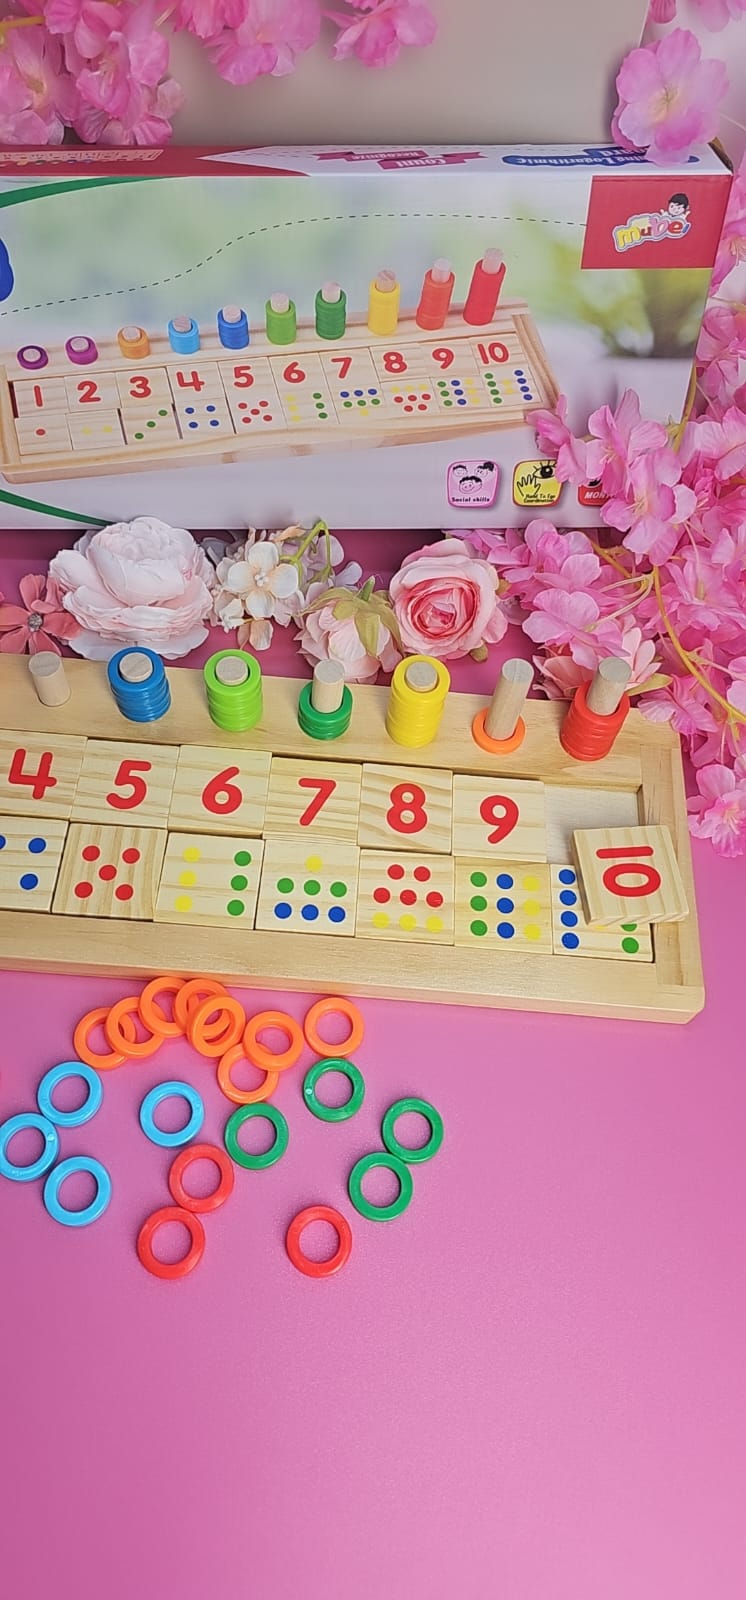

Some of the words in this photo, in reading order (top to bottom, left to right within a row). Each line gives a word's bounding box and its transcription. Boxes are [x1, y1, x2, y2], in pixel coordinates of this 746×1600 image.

[395, 158, 447, 168] Count
[515, 156, 616, 166] Logarithmic
[33, 385, 43, 407] 1
[77, 380, 101, 403] 2
[129, 375, 151, 398] 3
[176, 370, 205, 392] 4
[233, 365, 255, 388] 5
[283, 361, 306, 384] 6
[330, 356, 352, 379] 7
[382, 351, 408, 374] 8
[431, 347, 455, 370] 9
[477, 342, 510, 365] 10
[8, 748, 57, 800] 4
[105, 759, 152, 810] 5
[201, 766, 243, 815] 6
[298, 777, 337, 827] 7
[386, 782, 428, 834] 8
[479, 794, 520, 844] 9
[595, 845, 662, 897] 10
